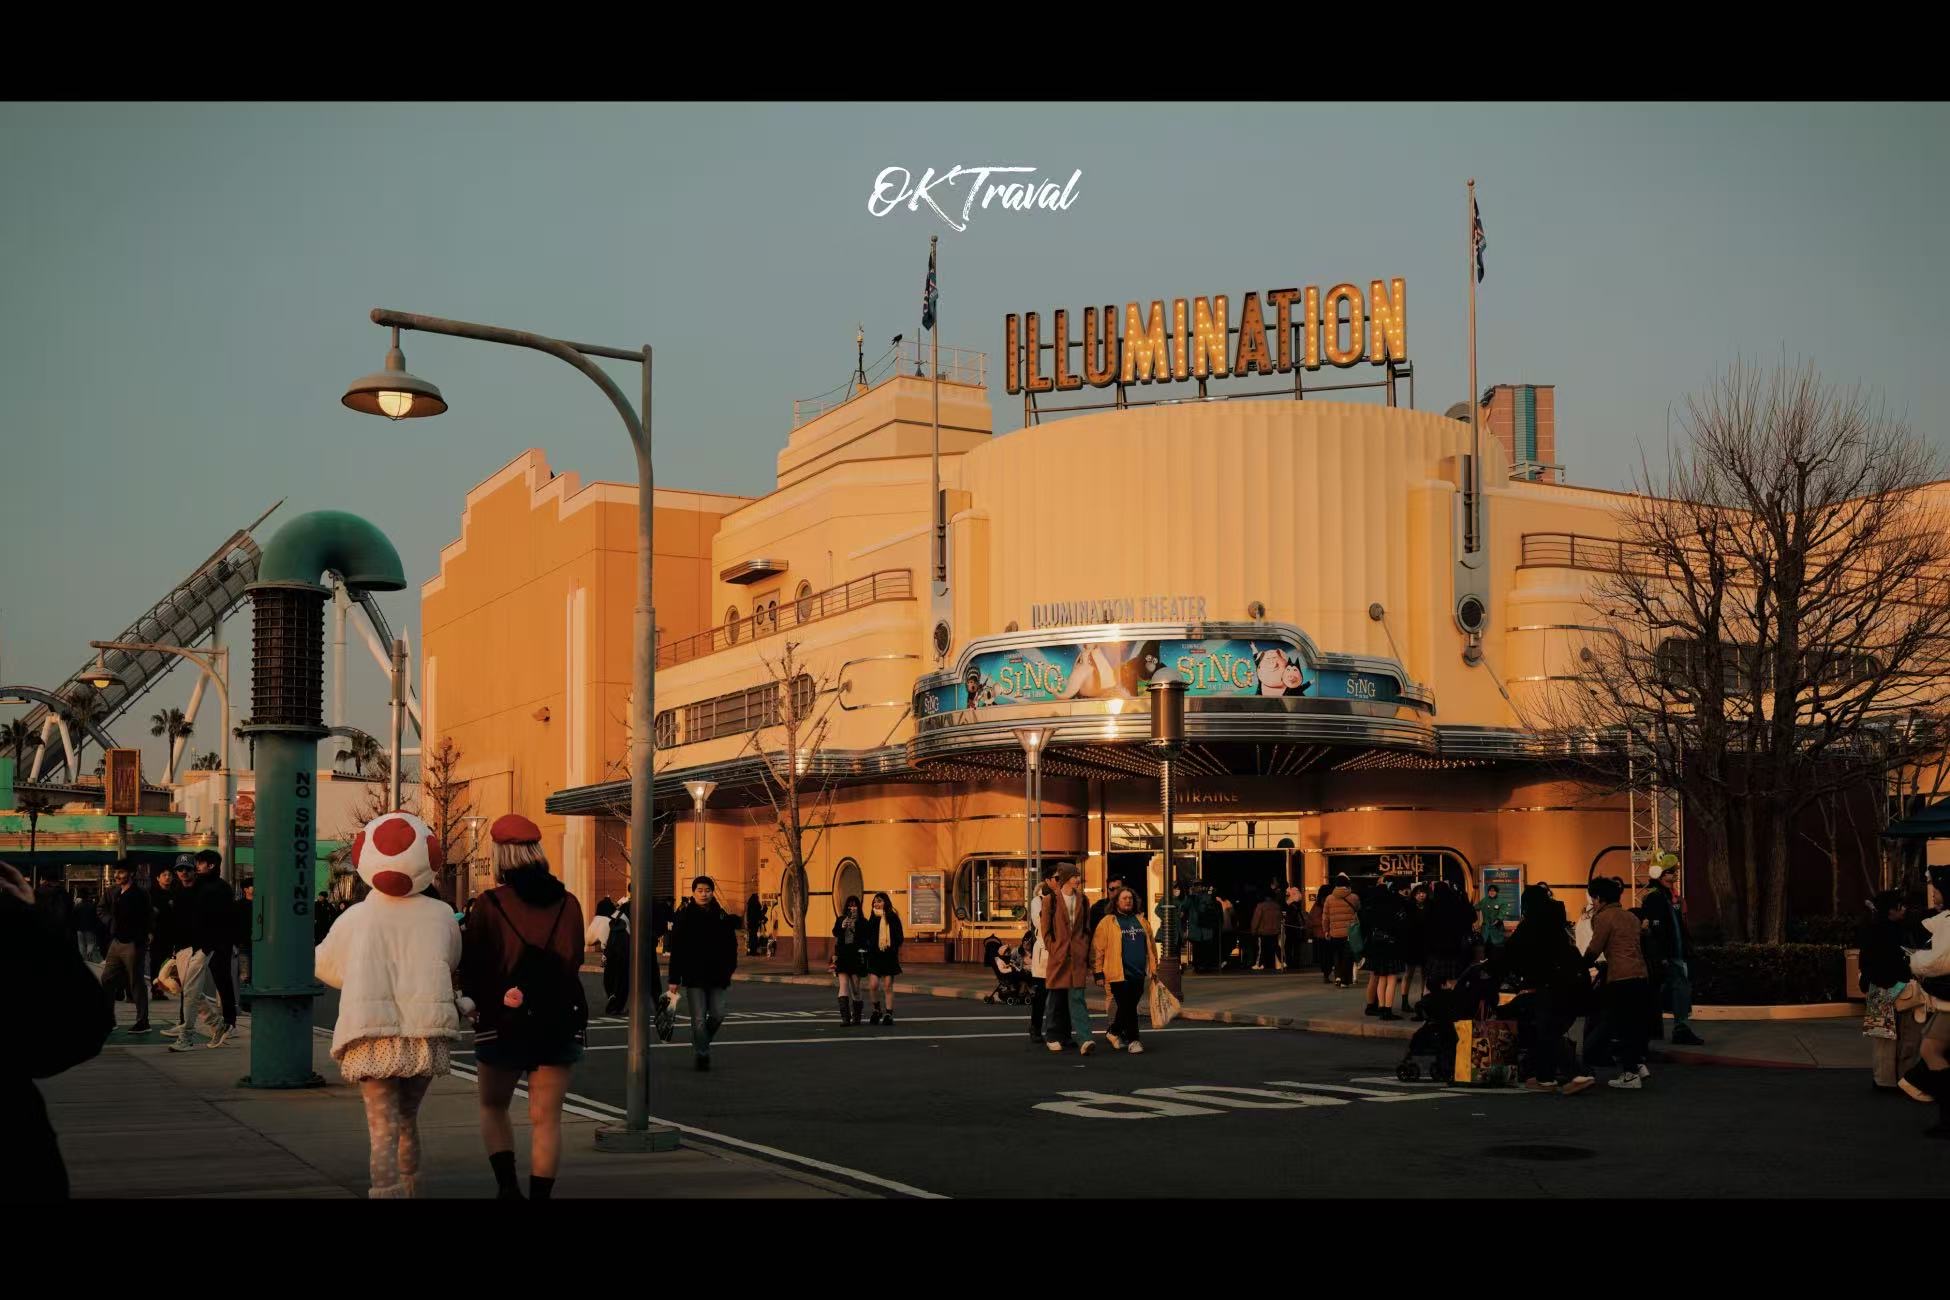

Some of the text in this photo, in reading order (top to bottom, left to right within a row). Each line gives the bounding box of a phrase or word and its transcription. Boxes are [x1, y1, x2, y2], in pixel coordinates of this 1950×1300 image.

[1005, 277, 1407, 396] ILLUMINATION
[1032, 595, 1207, 628] ILLUMINATION THEATER
[1000, 661, 1064, 698] SING
[1177, 653, 1254, 690] SING
[1346, 678, 1376, 698] SING
[296, 772, 310, 798] NO
[293, 807, 309, 916] SMOKING
[1379, 854, 1424, 873] SING
